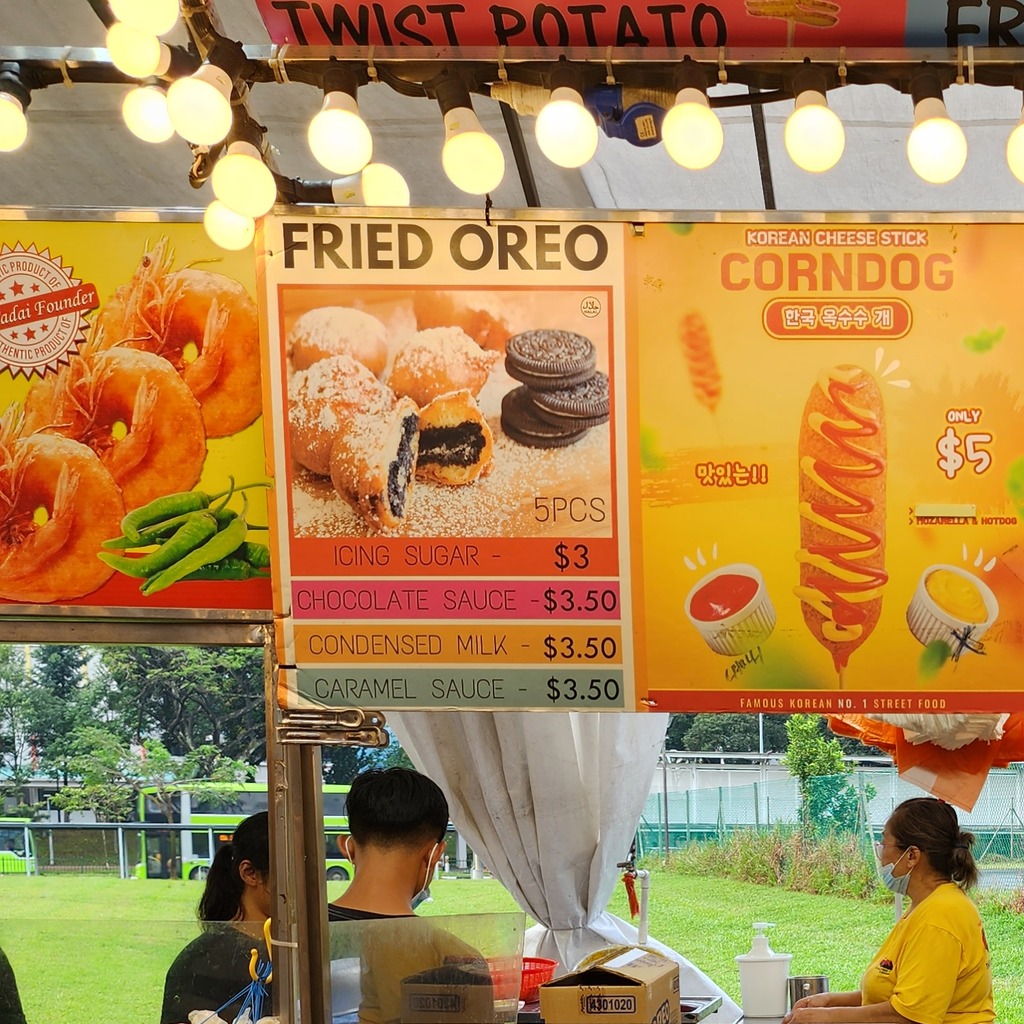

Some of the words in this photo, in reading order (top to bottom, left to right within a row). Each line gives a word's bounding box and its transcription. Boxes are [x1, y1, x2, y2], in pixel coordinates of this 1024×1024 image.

[283, 223, 433, 270] FRIED
[449, 224, 609, 271] OREO
[747, 231, 810, 245] KOREAN
[816, 231, 876, 245] CHEESE
[881, 231, 928, 246] STICK
[720, 253, 954, 291] CORNDOG
[35, 289, 95, 316] Founder
[784, 308, 815, 326] 한국
[822, 308, 868, 327] 옥수수
[874, 308, 892, 326] 개
[947, 410, 981, 423] ONLY
[937, 427, 992, 478] $5
[697, 463, 767, 486] 맛있는!!
[535, 497, 606, 523] 5PCS
[334, 545, 389, 566] ICING
[405, 545, 479, 566] SUGAR
[554, 542, 589, 573] $3
[297, 590, 429, 610] CHOCOLATE
[443, 590, 516, 610] SAUCE
[543, 587, 616, 614] $3.50
[309, 635, 442, 655] CONDENSED
[457, 635, 508, 655] MILK
[543, 634, 616, 661] $3.50
[315, 678, 416, 699] CARAMEL
[431, 679, 504, 699] SAUCE
[547, 675, 620, 703] $3.50
[740, 698, 784, 709] FAMOUS
[789, 698, 833, 709] KOREAN
[838, 699, 856, 709] NO.
[873, 699, 913, 709] STREET
[918, 699, 947, 709] FOOD
